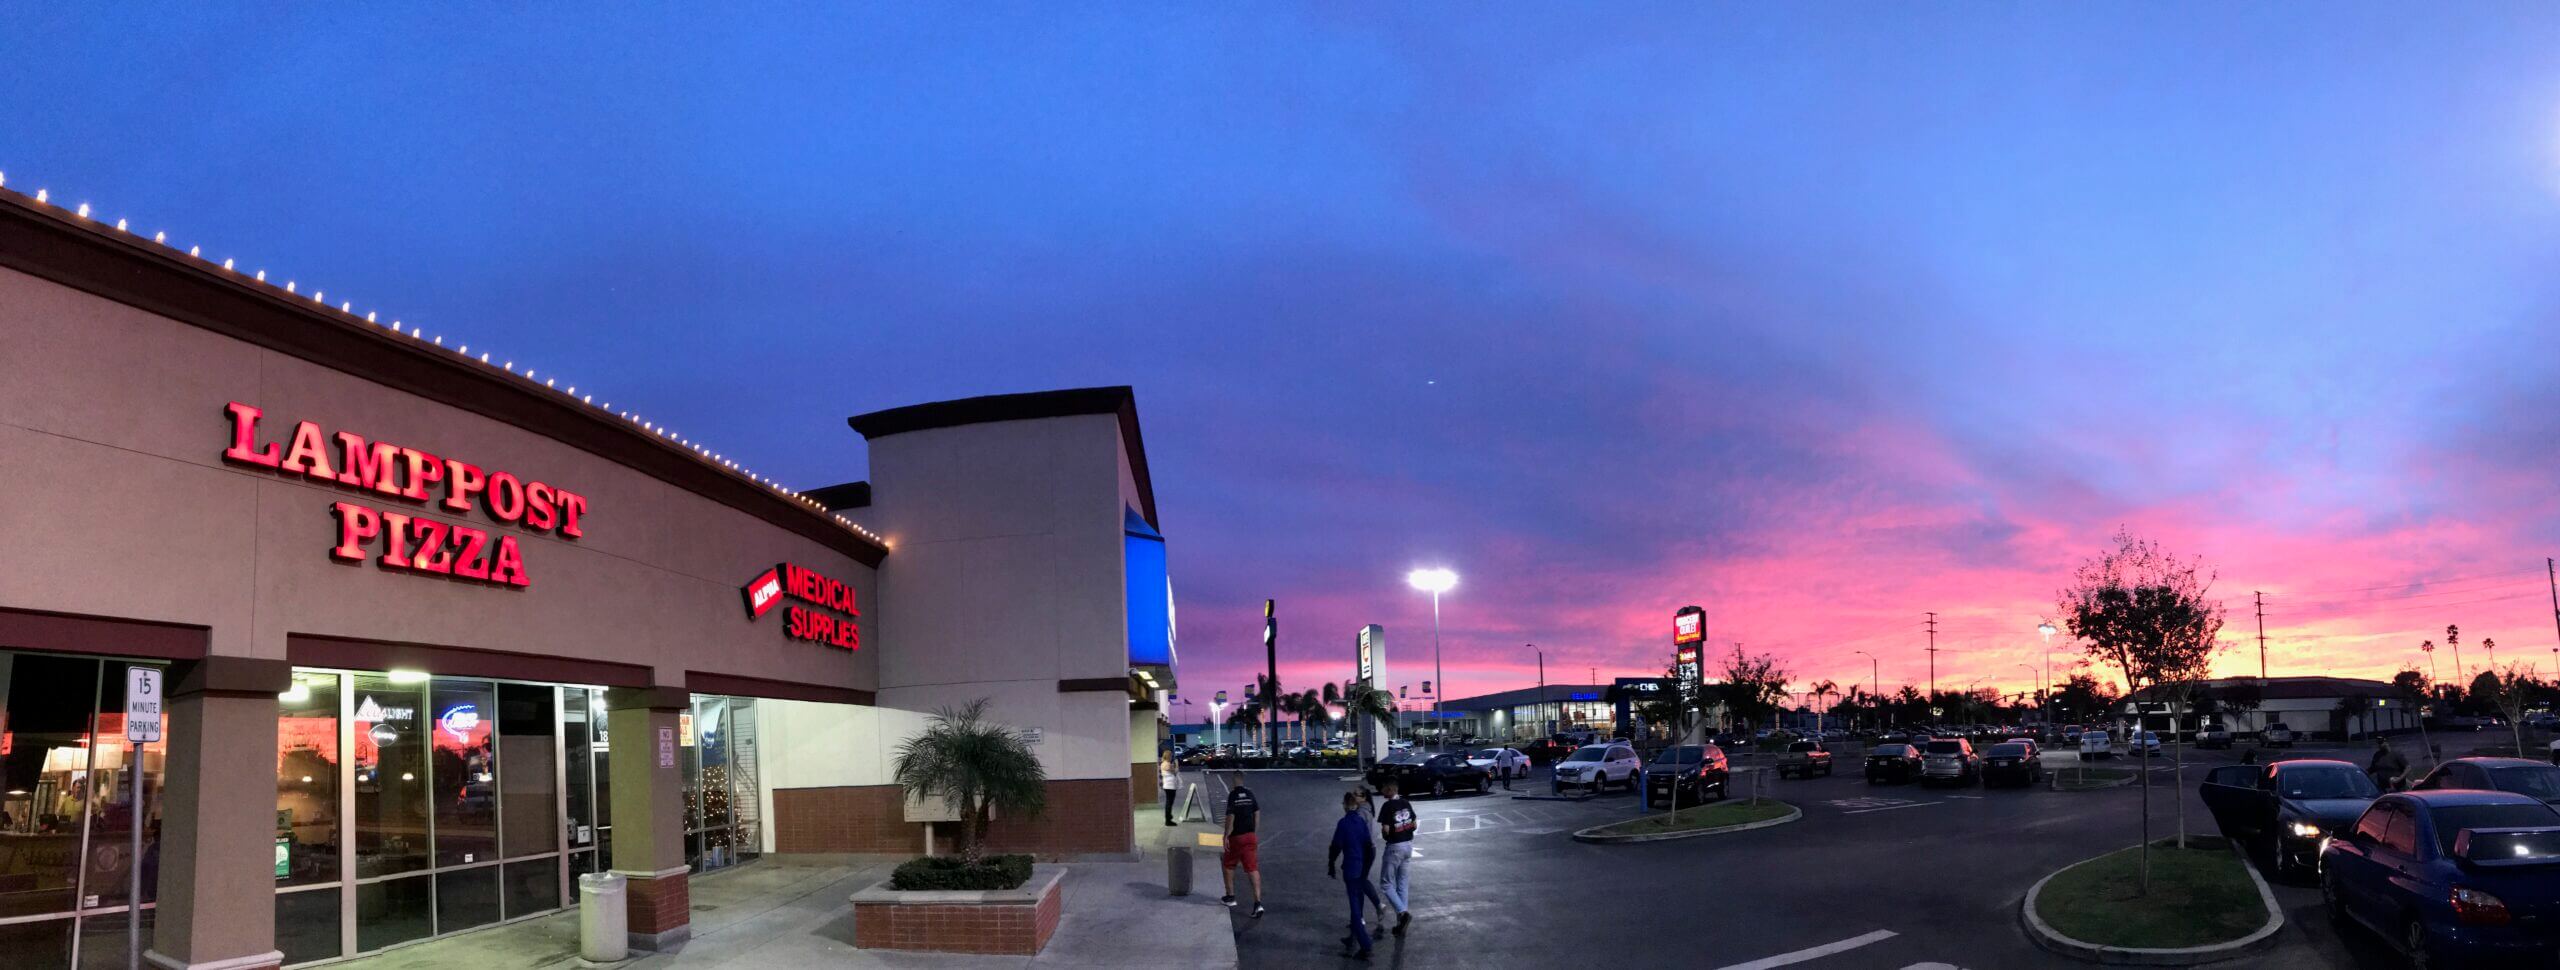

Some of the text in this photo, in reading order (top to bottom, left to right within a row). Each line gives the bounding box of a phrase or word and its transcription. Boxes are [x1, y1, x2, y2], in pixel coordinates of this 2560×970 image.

[225, 401, 587, 538] LAMPPOST
[332, 502, 530, 587] PIZZA
[786, 561, 861, 617] MEDICAL
[789, 604, 860, 652] SUPPLIES
[132, 701, 157, 714] MINUTE
[139, 678, 151, 695] 15
[129, 720, 159, 733] PARKING
